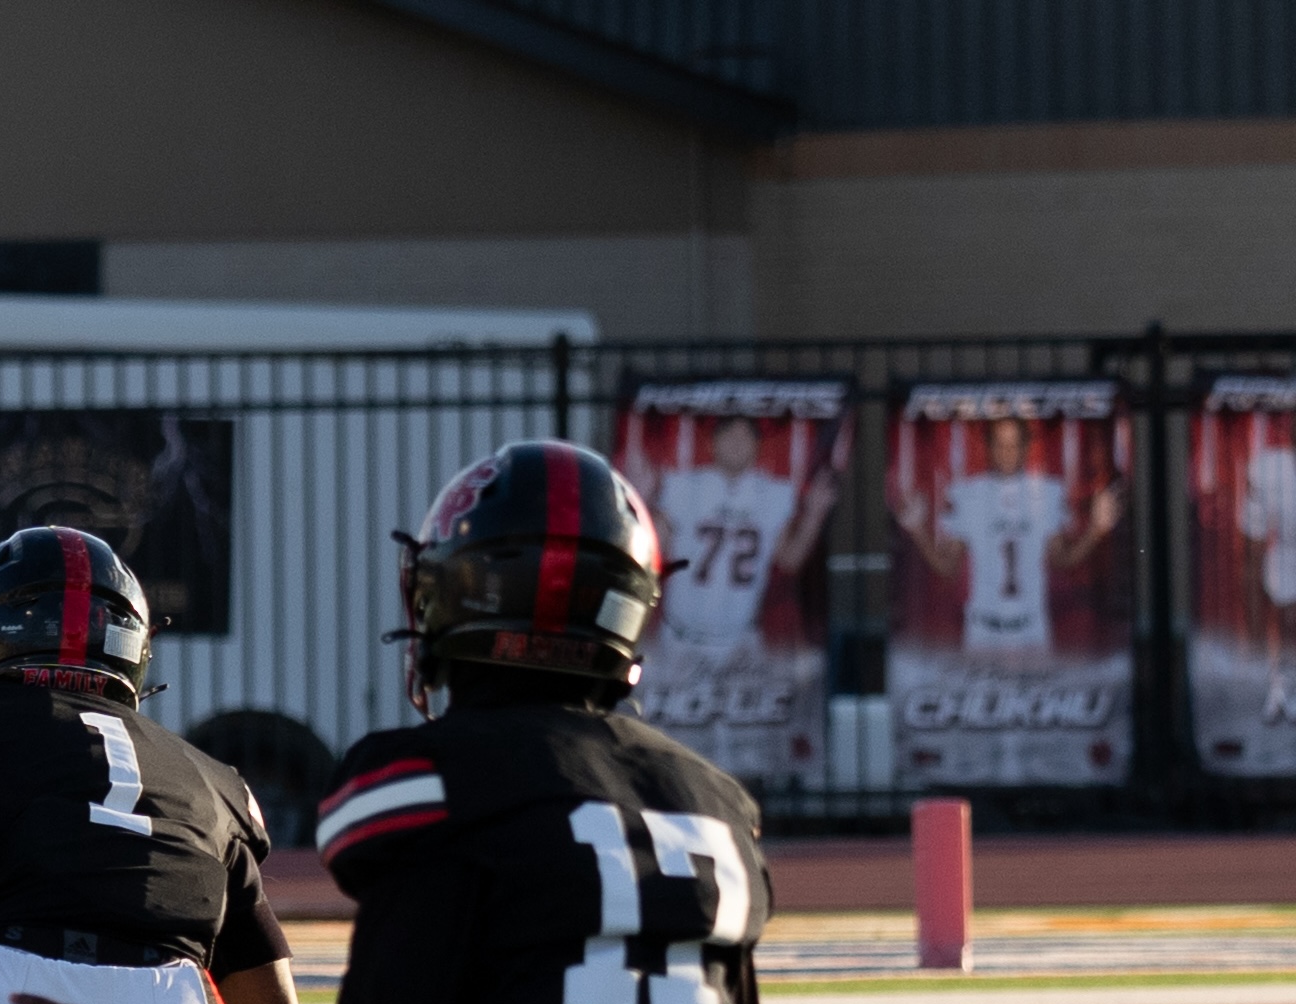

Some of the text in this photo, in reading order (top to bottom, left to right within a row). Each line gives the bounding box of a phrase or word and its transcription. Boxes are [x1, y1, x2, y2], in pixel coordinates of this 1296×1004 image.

[694, 520, 761, 590] 72
[999, 538, 1024, 600] 1
[22, 667, 109, 697] FAMILY
[79, 711, 153, 836] 1
